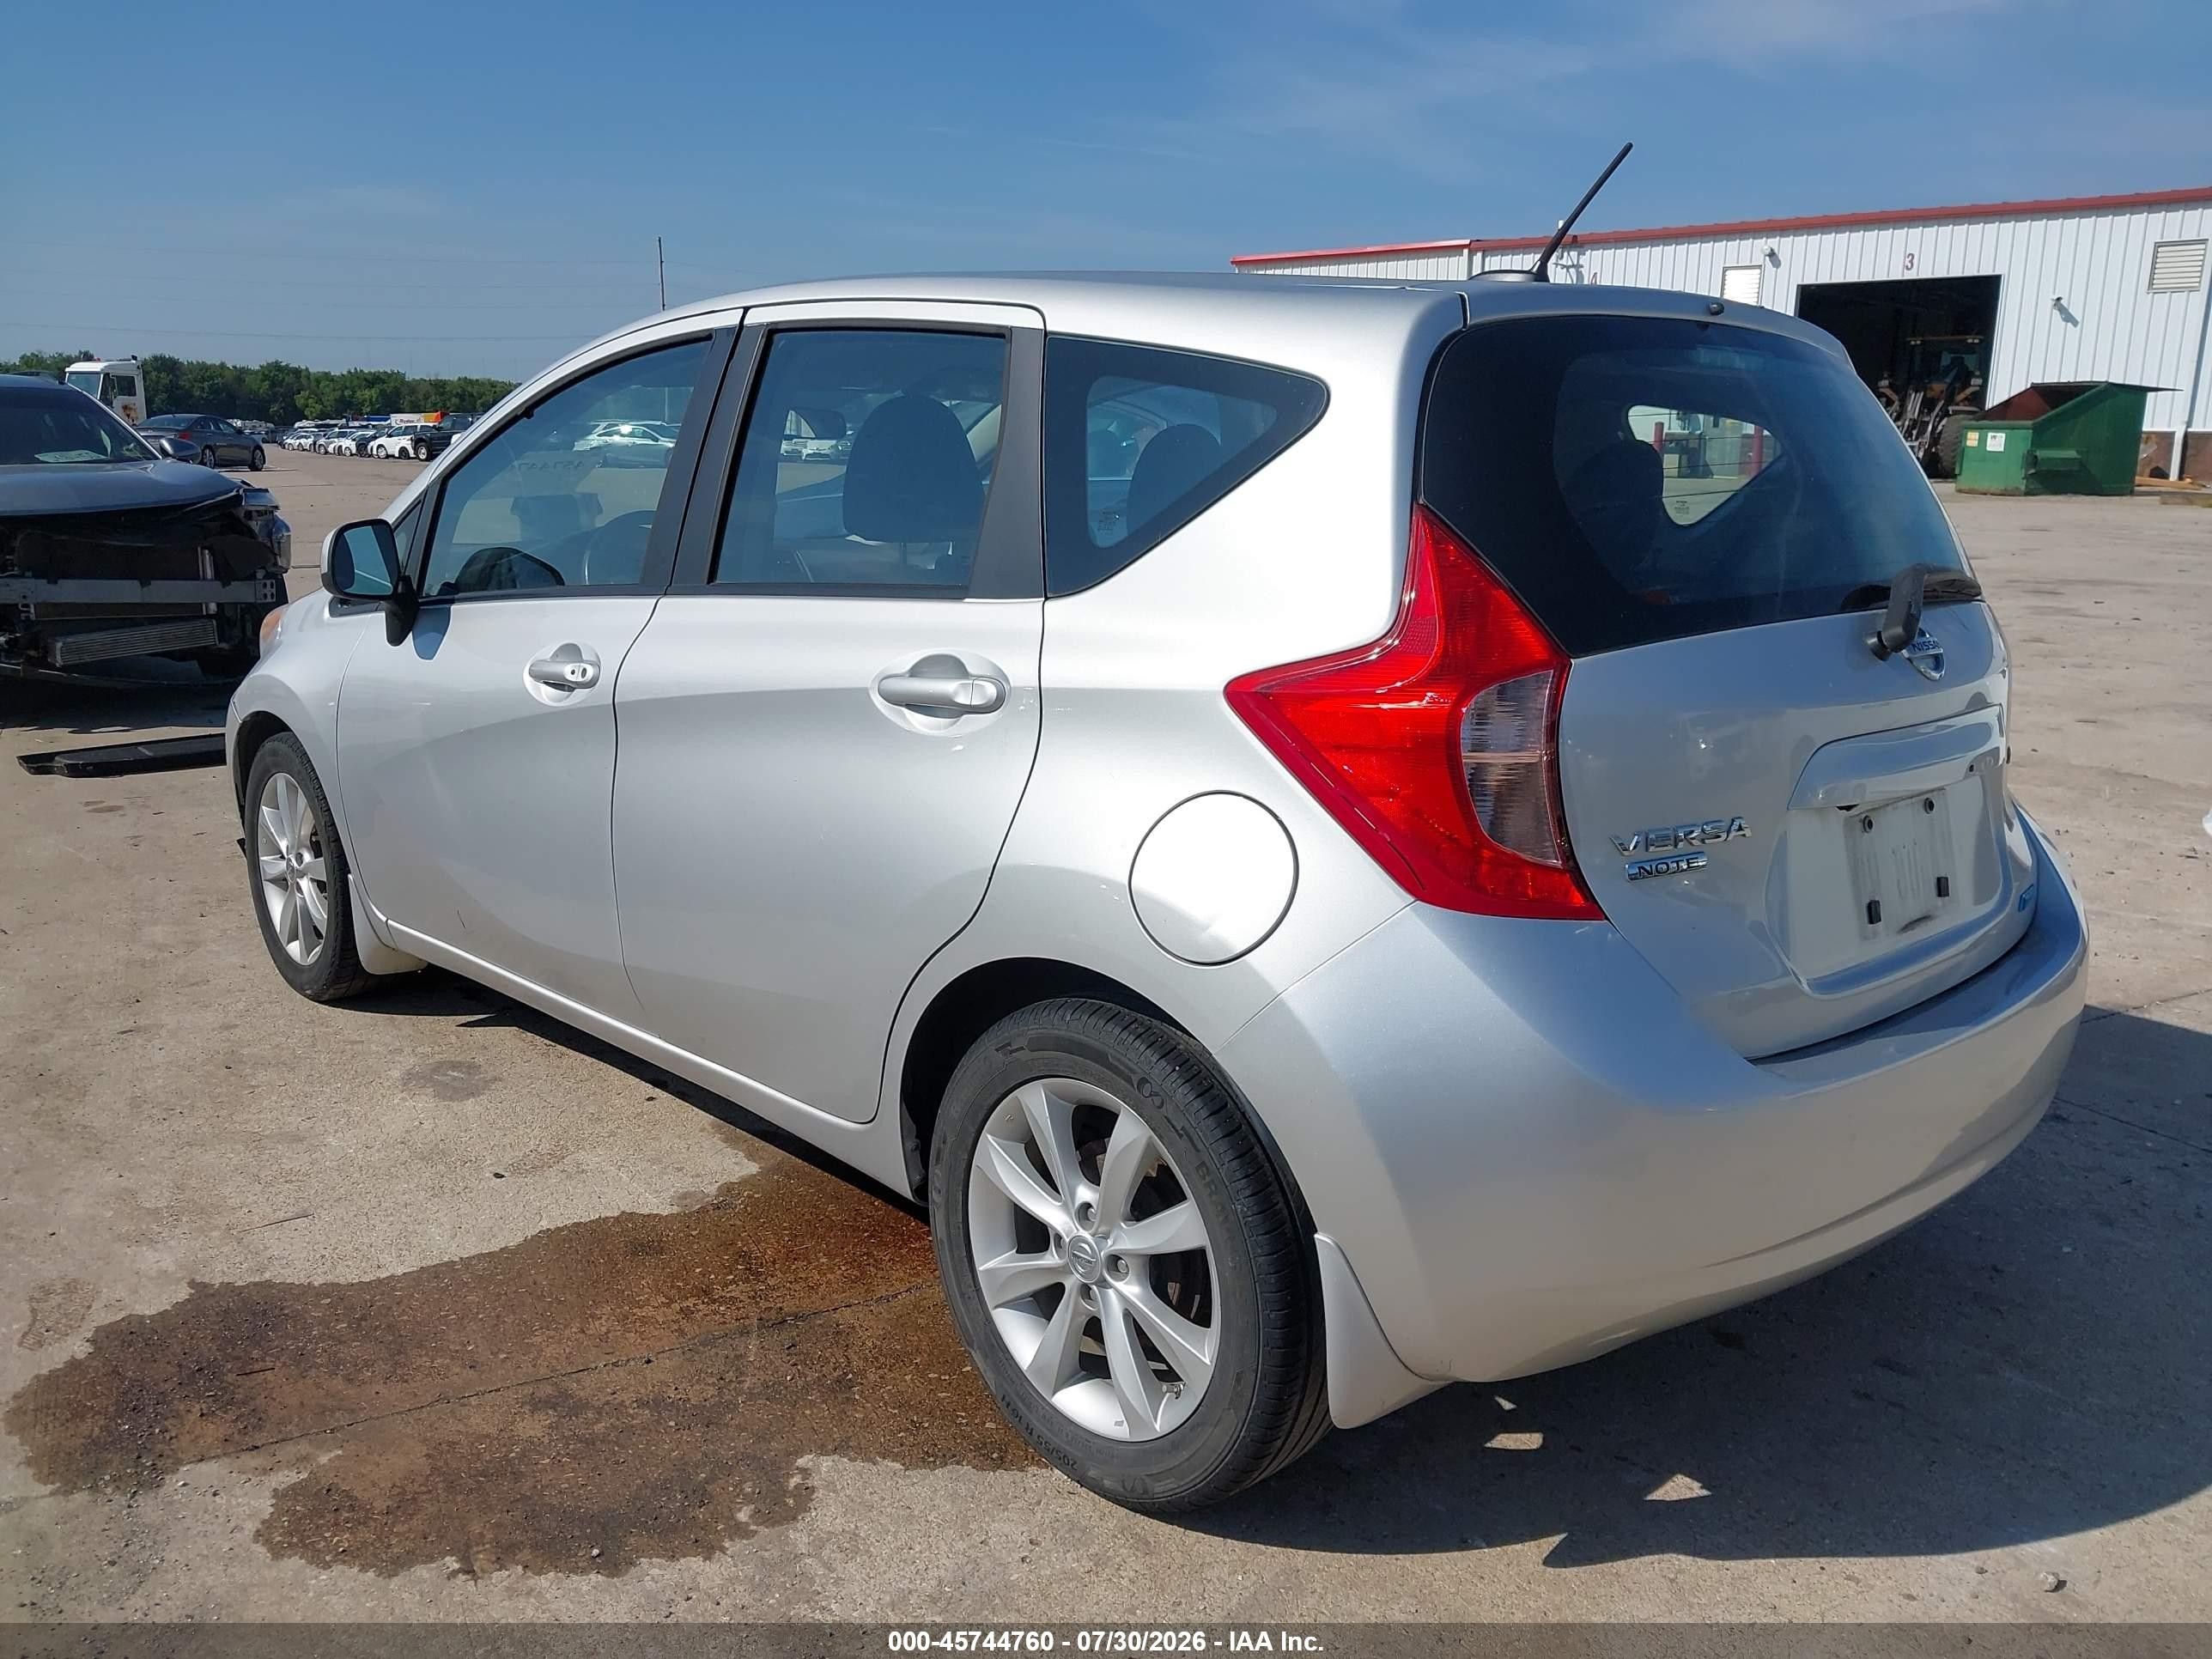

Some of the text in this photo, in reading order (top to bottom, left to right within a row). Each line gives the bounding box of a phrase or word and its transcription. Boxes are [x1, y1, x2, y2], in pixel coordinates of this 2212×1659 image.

[1905, 252, 1915, 271] 3
[1608, 816, 1753, 856] VERSA
[1637, 856, 1700, 878] NOTE
